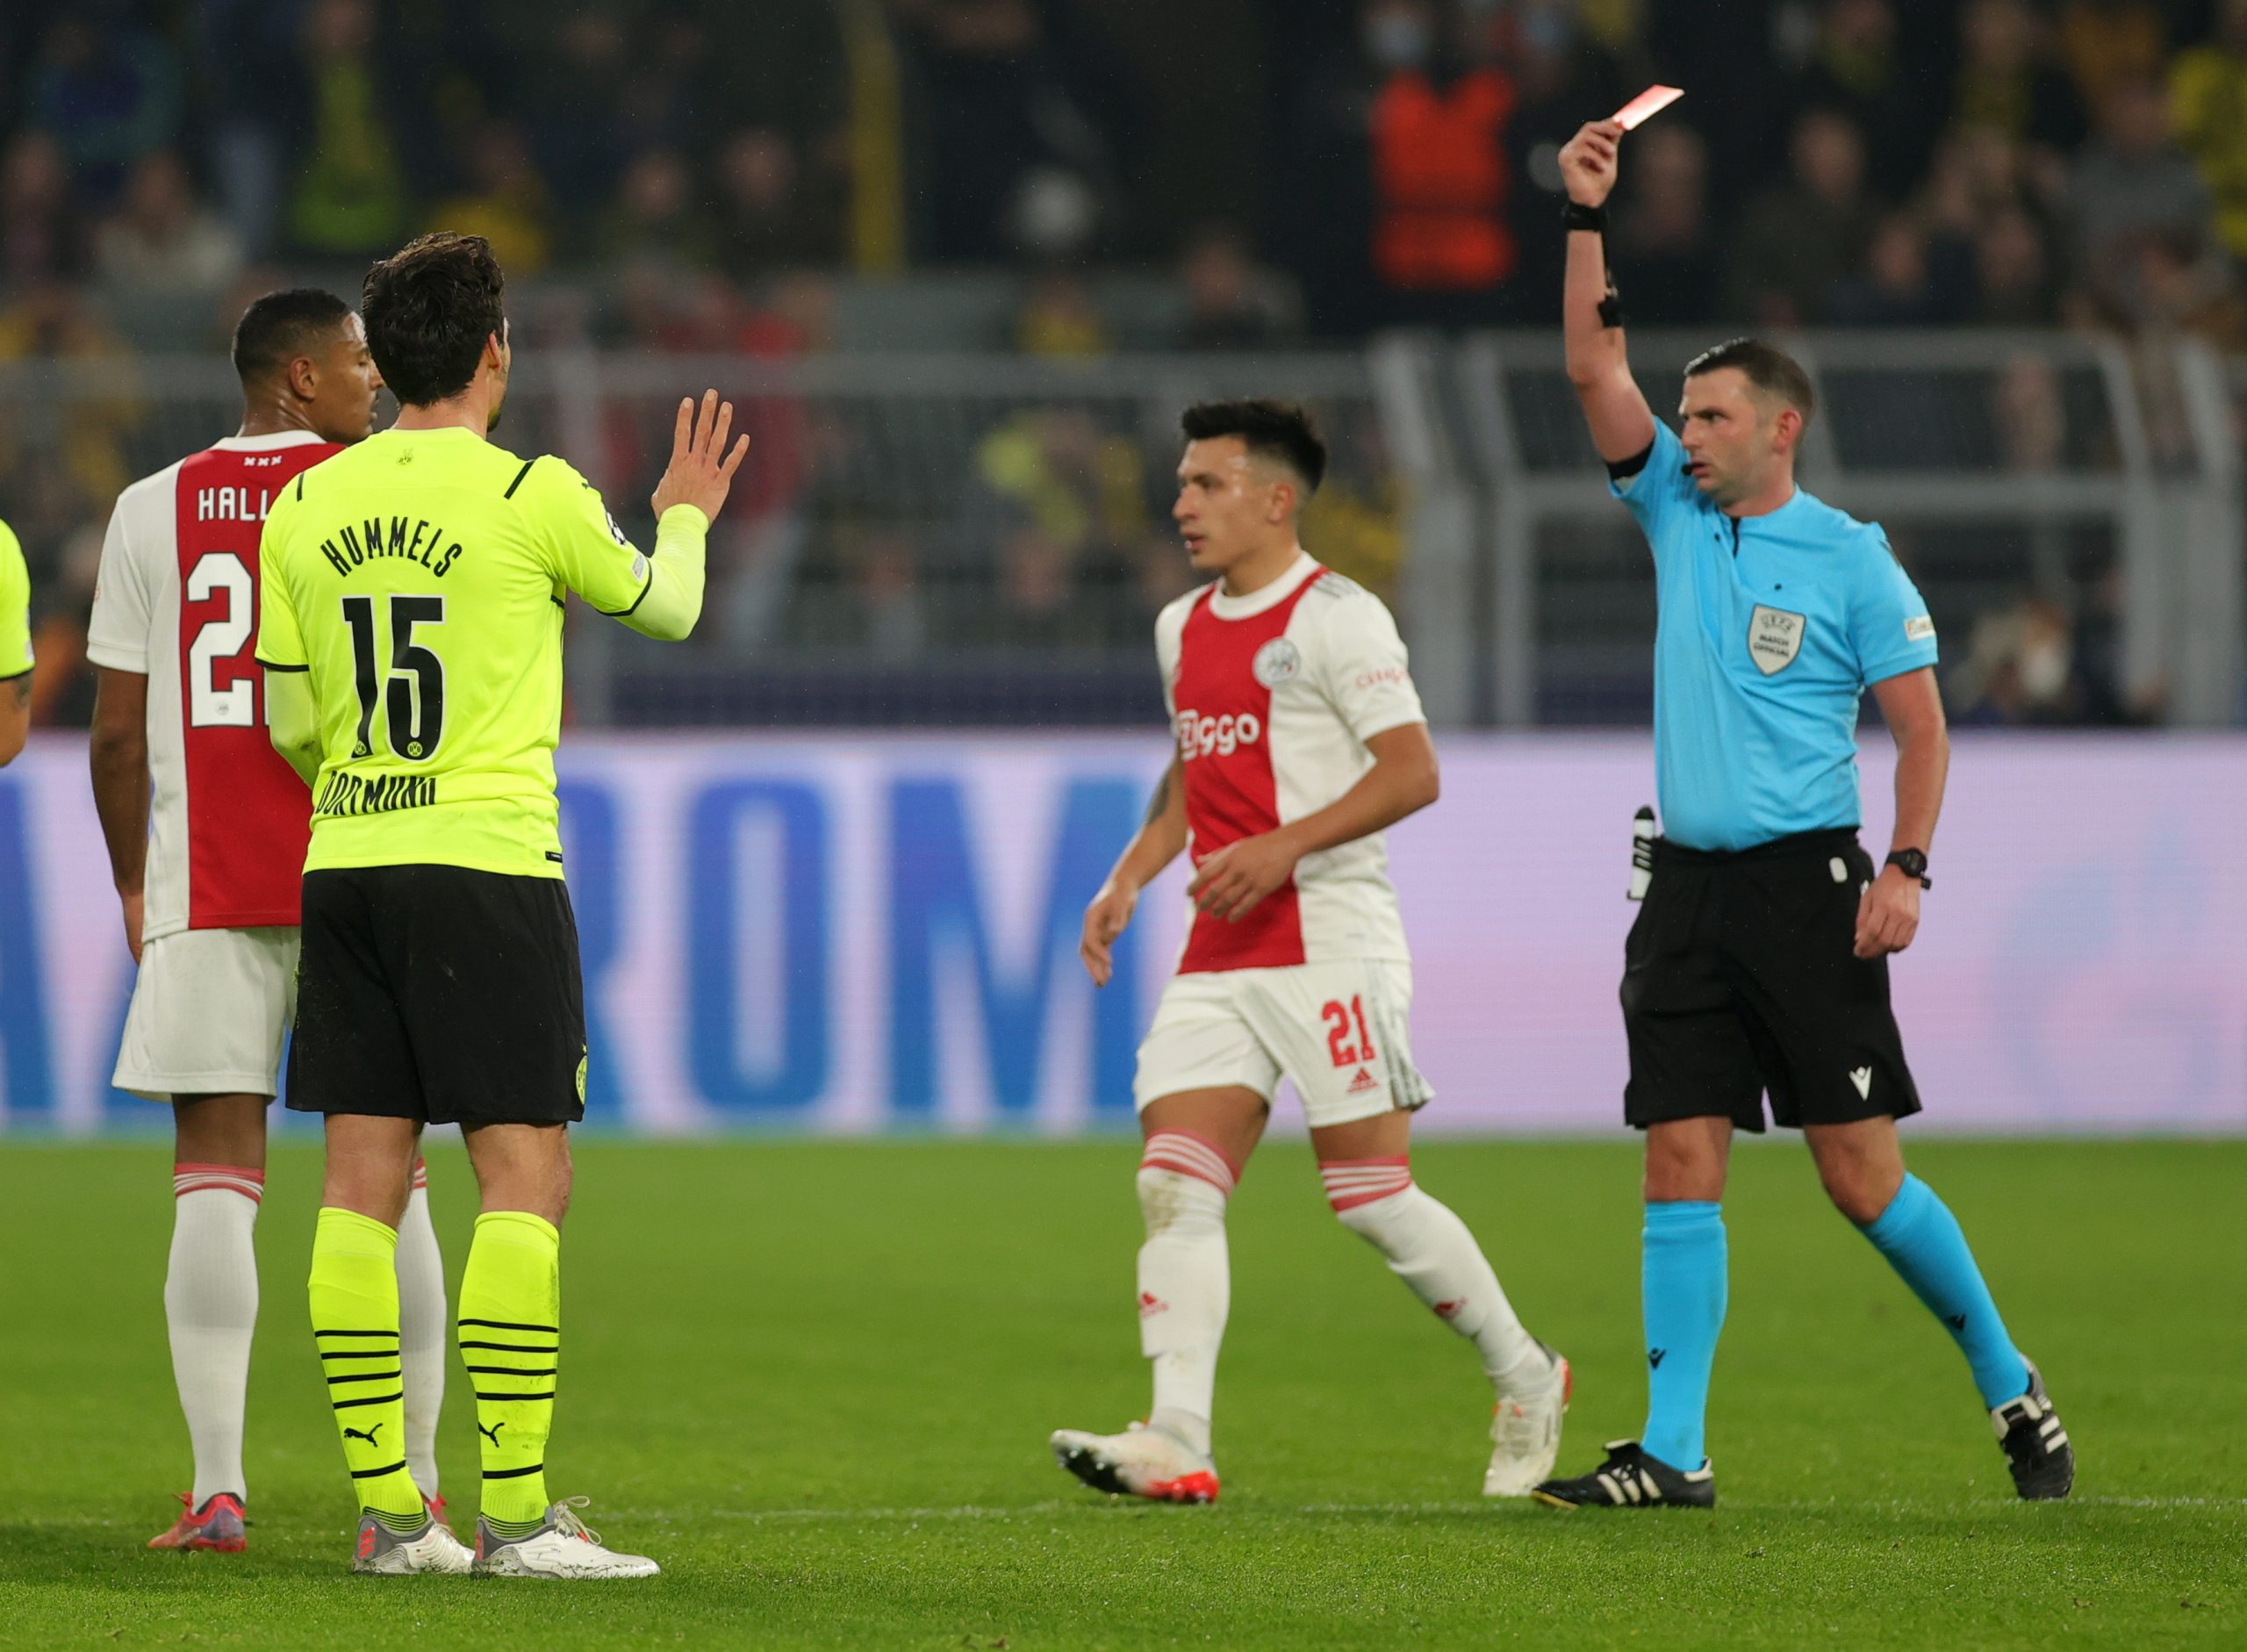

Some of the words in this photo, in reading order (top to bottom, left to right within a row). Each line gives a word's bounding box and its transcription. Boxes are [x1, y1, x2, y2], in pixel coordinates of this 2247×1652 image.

[198, 486, 268, 521] HALL
[319, 516, 463, 578] HUMMELS
[187, 552, 255, 728] 2
[1753, 642, 1790, 657] OFFICIAL
[1759, 634, 1790, 646] MATCH
[341, 596, 444, 762] 15
[1321, 994, 1375, 1068] 21
